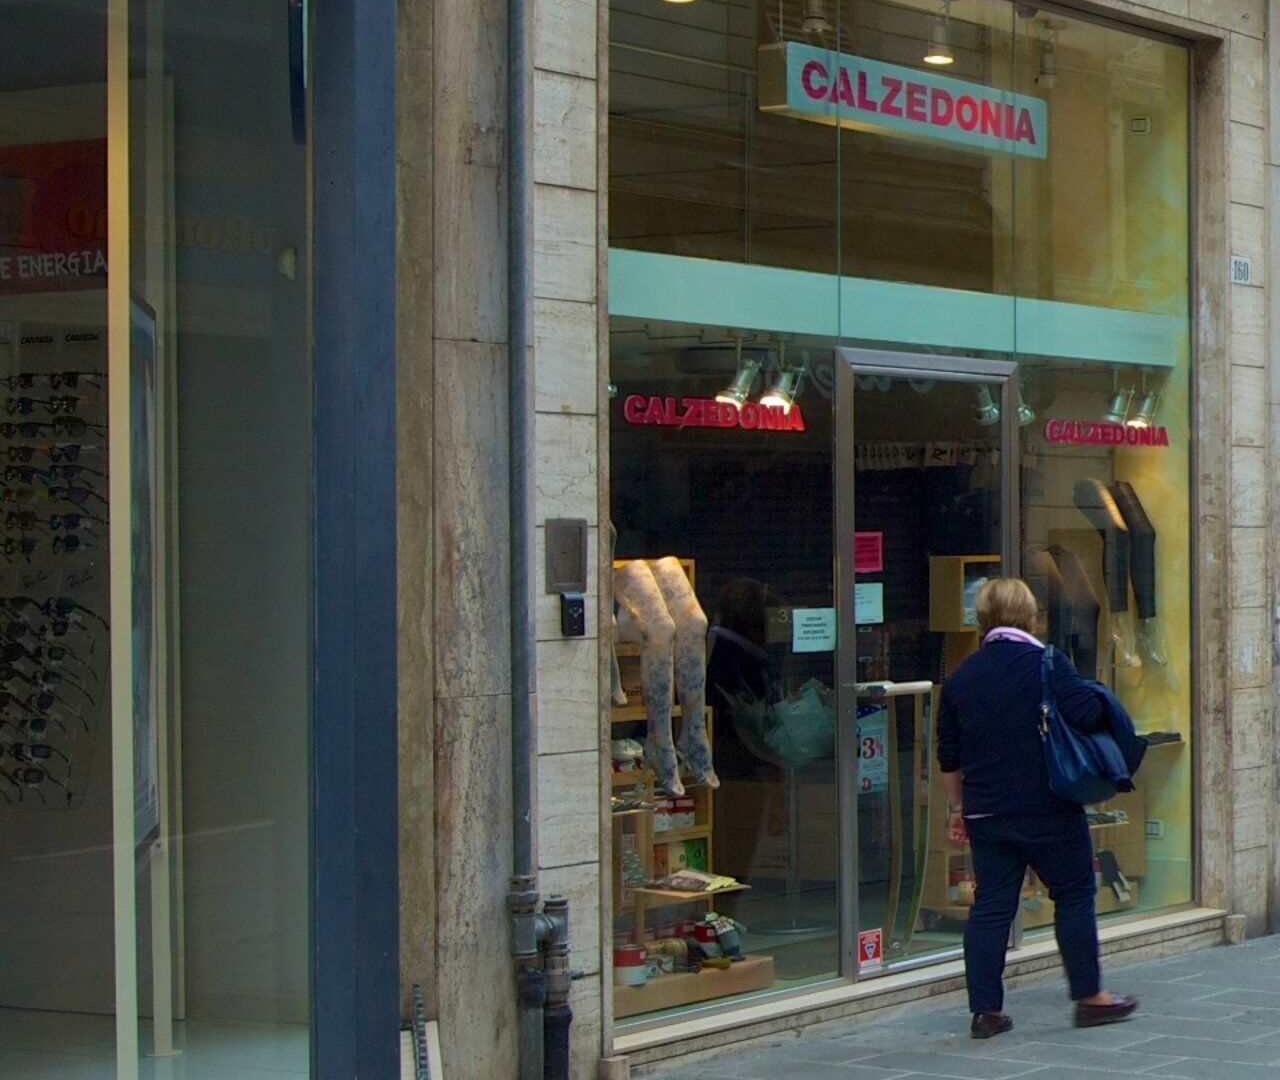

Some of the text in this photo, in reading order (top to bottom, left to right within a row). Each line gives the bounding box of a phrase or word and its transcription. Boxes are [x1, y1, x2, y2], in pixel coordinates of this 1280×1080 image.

[801, 60, 1037, 146] CALZEDONIA
[17, 250, 108, 278] ENERGIA
[623, 394, 806, 432] CALZEDONIA
[1045, 419, 1170, 448] CALZEDONIA
